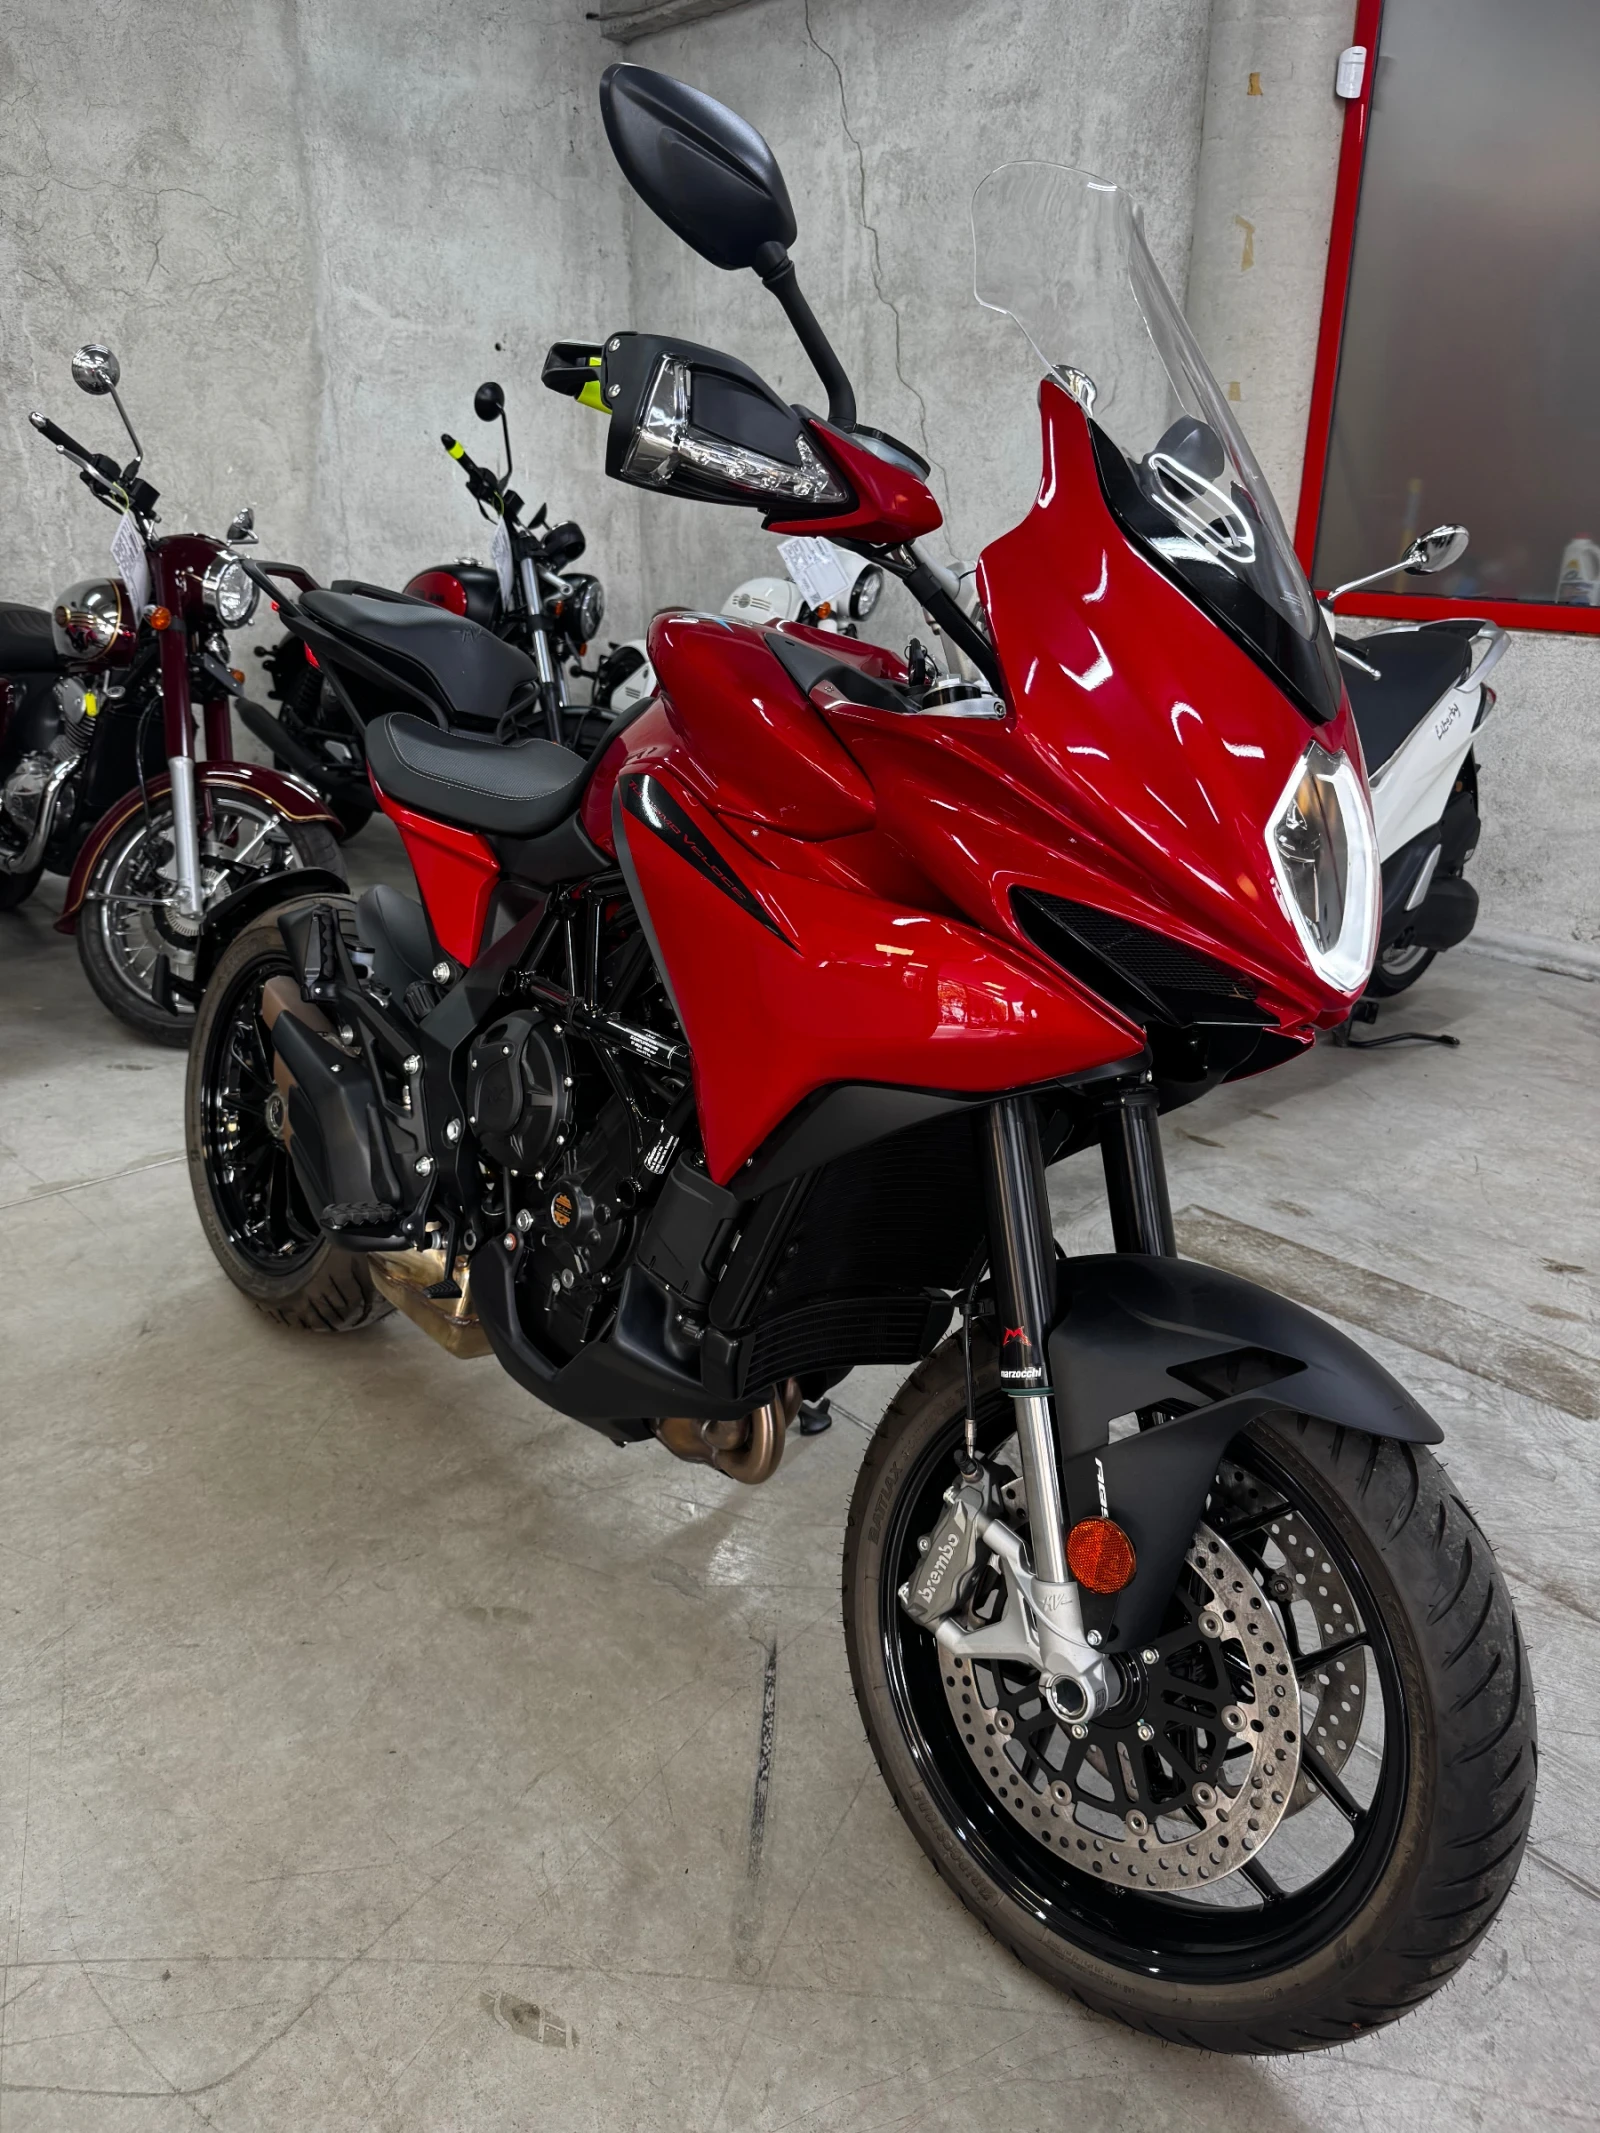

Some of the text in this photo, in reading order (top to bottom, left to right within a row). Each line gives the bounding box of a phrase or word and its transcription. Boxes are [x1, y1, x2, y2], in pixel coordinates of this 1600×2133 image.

[1435, 703, 1461, 740] Liberty
[683, 834, 746, 900] VELOCE
[1001, 1366, 1042, 1379] marzocchi
[919, 1533, 961, 1604] brembo
